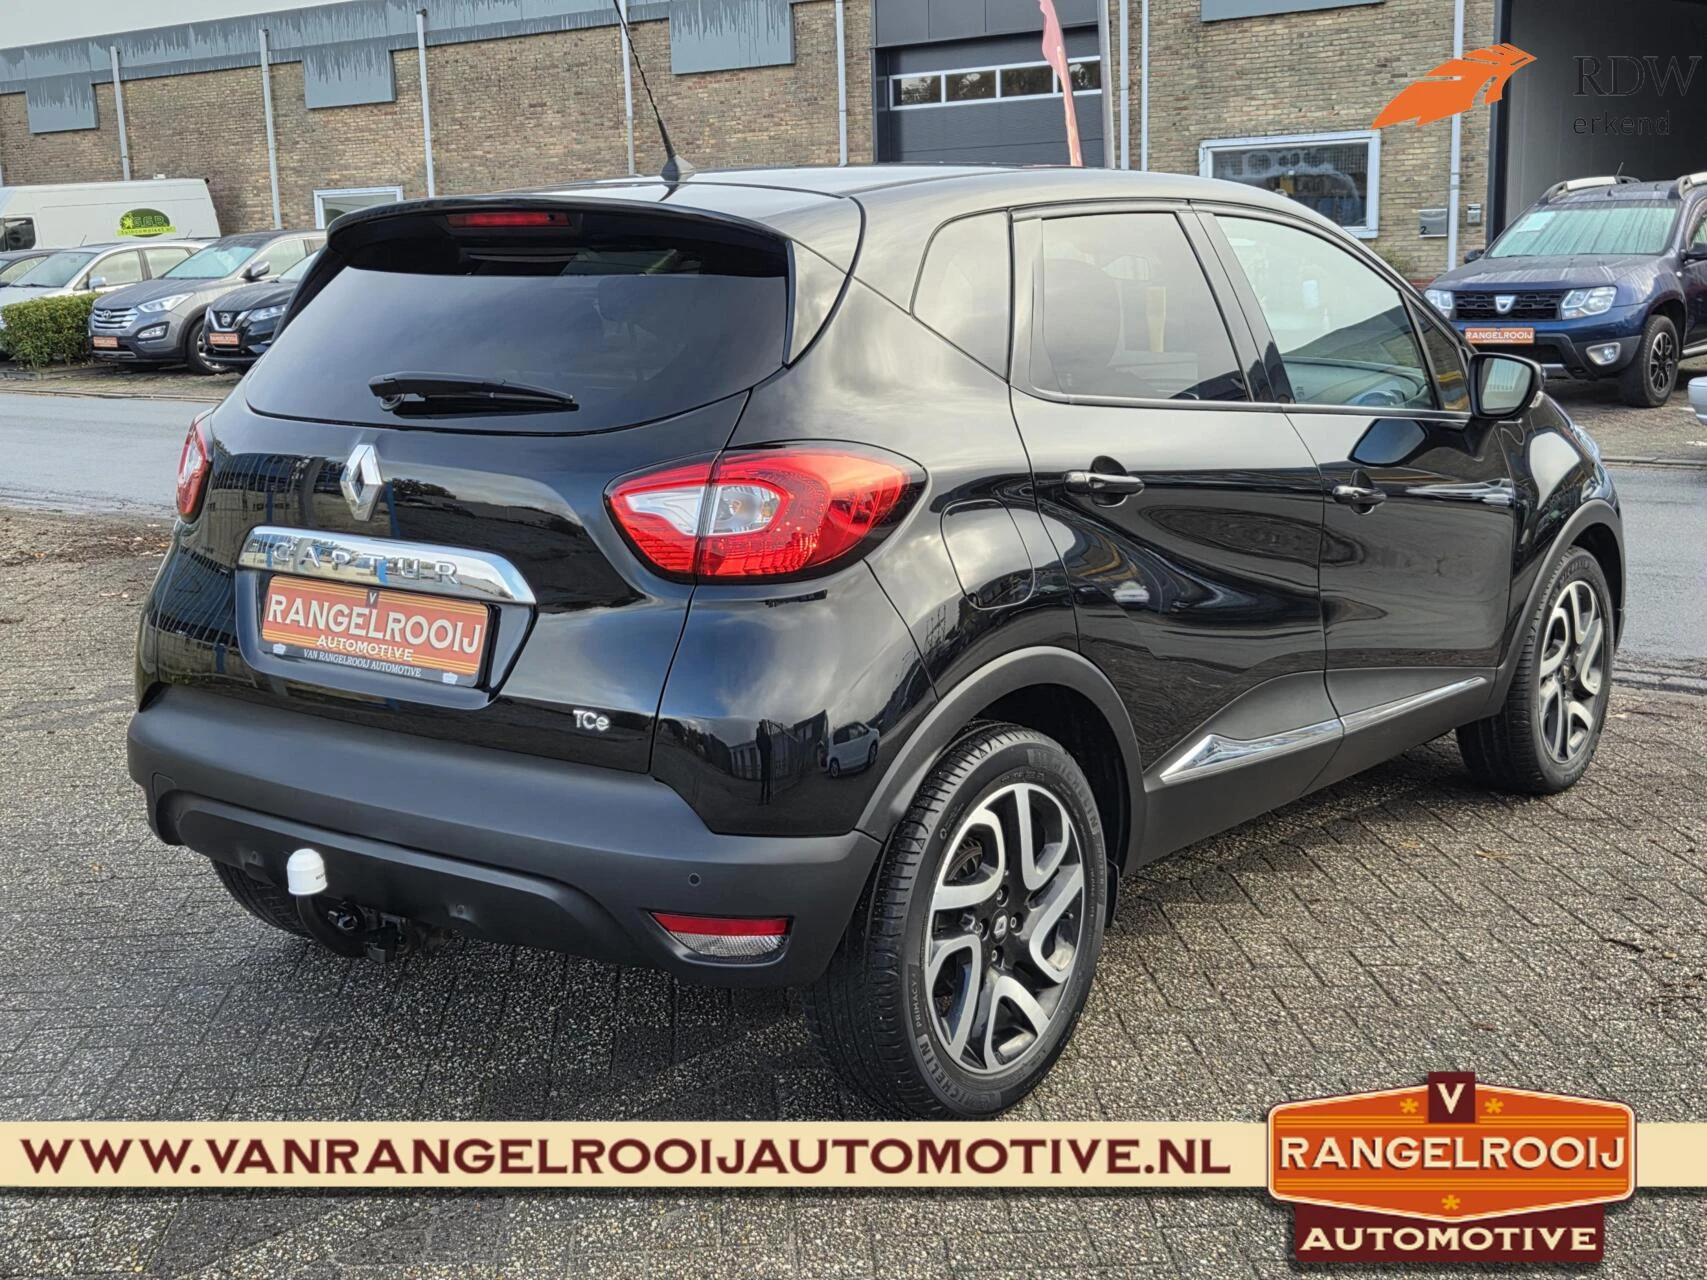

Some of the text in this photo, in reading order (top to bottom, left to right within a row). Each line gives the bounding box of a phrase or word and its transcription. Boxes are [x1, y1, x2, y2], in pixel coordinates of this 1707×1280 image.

[1465, 331, 1534, 340] RANGELROOIJ
[274, 542, 459, 585] CAPTUR
[369, 592, 377, 605] V
[268, 594, 482, 654] RANGELROOIJ
[317, 634, 415, 662] AUTOMOTIVE
[303, 649, 422, 678] VAN RANGELROOIJ AUTOMOTIVE
[573, 709, 609, 731] TCe
